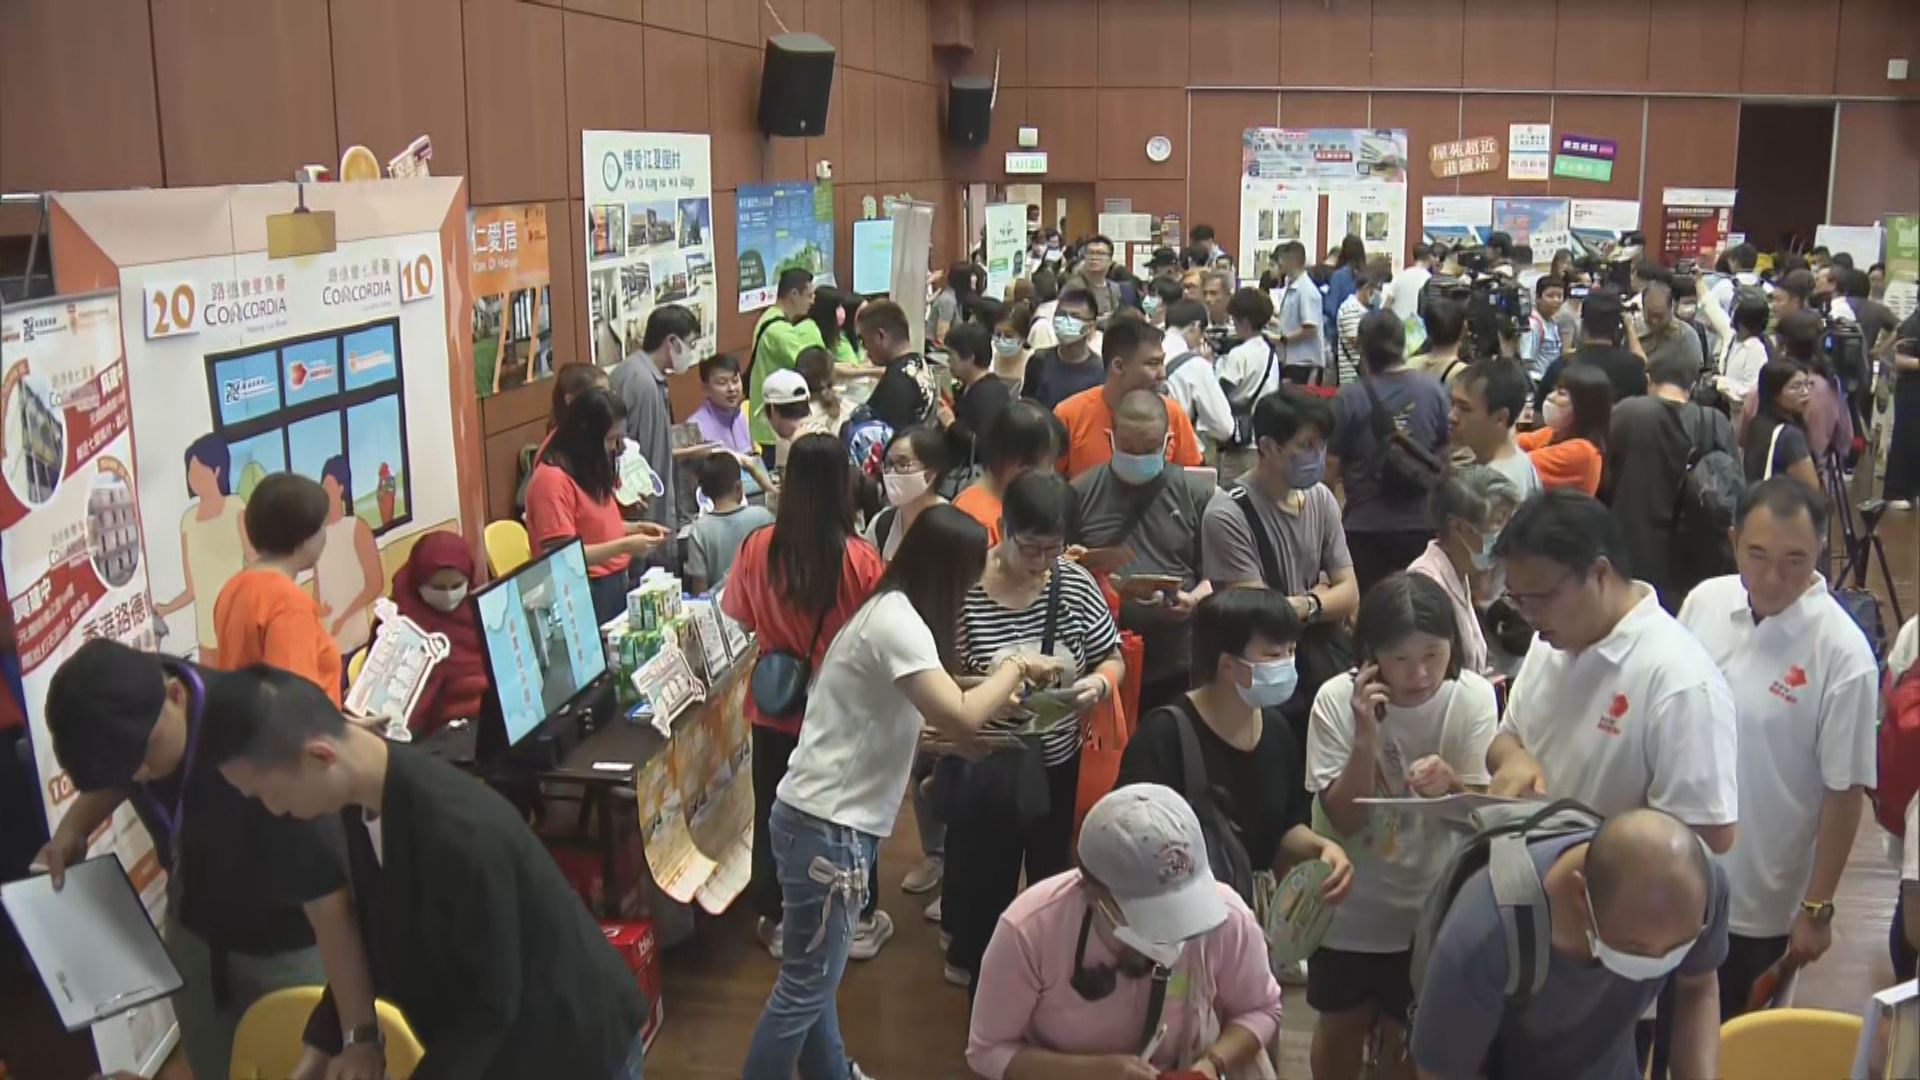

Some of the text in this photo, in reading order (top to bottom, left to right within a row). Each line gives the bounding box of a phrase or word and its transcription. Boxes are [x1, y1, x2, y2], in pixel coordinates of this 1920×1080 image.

[472, 219, 518, 256] 仁愛居
[403, 253, 434, 297] 10
[153, 283, 196, 335] 20
